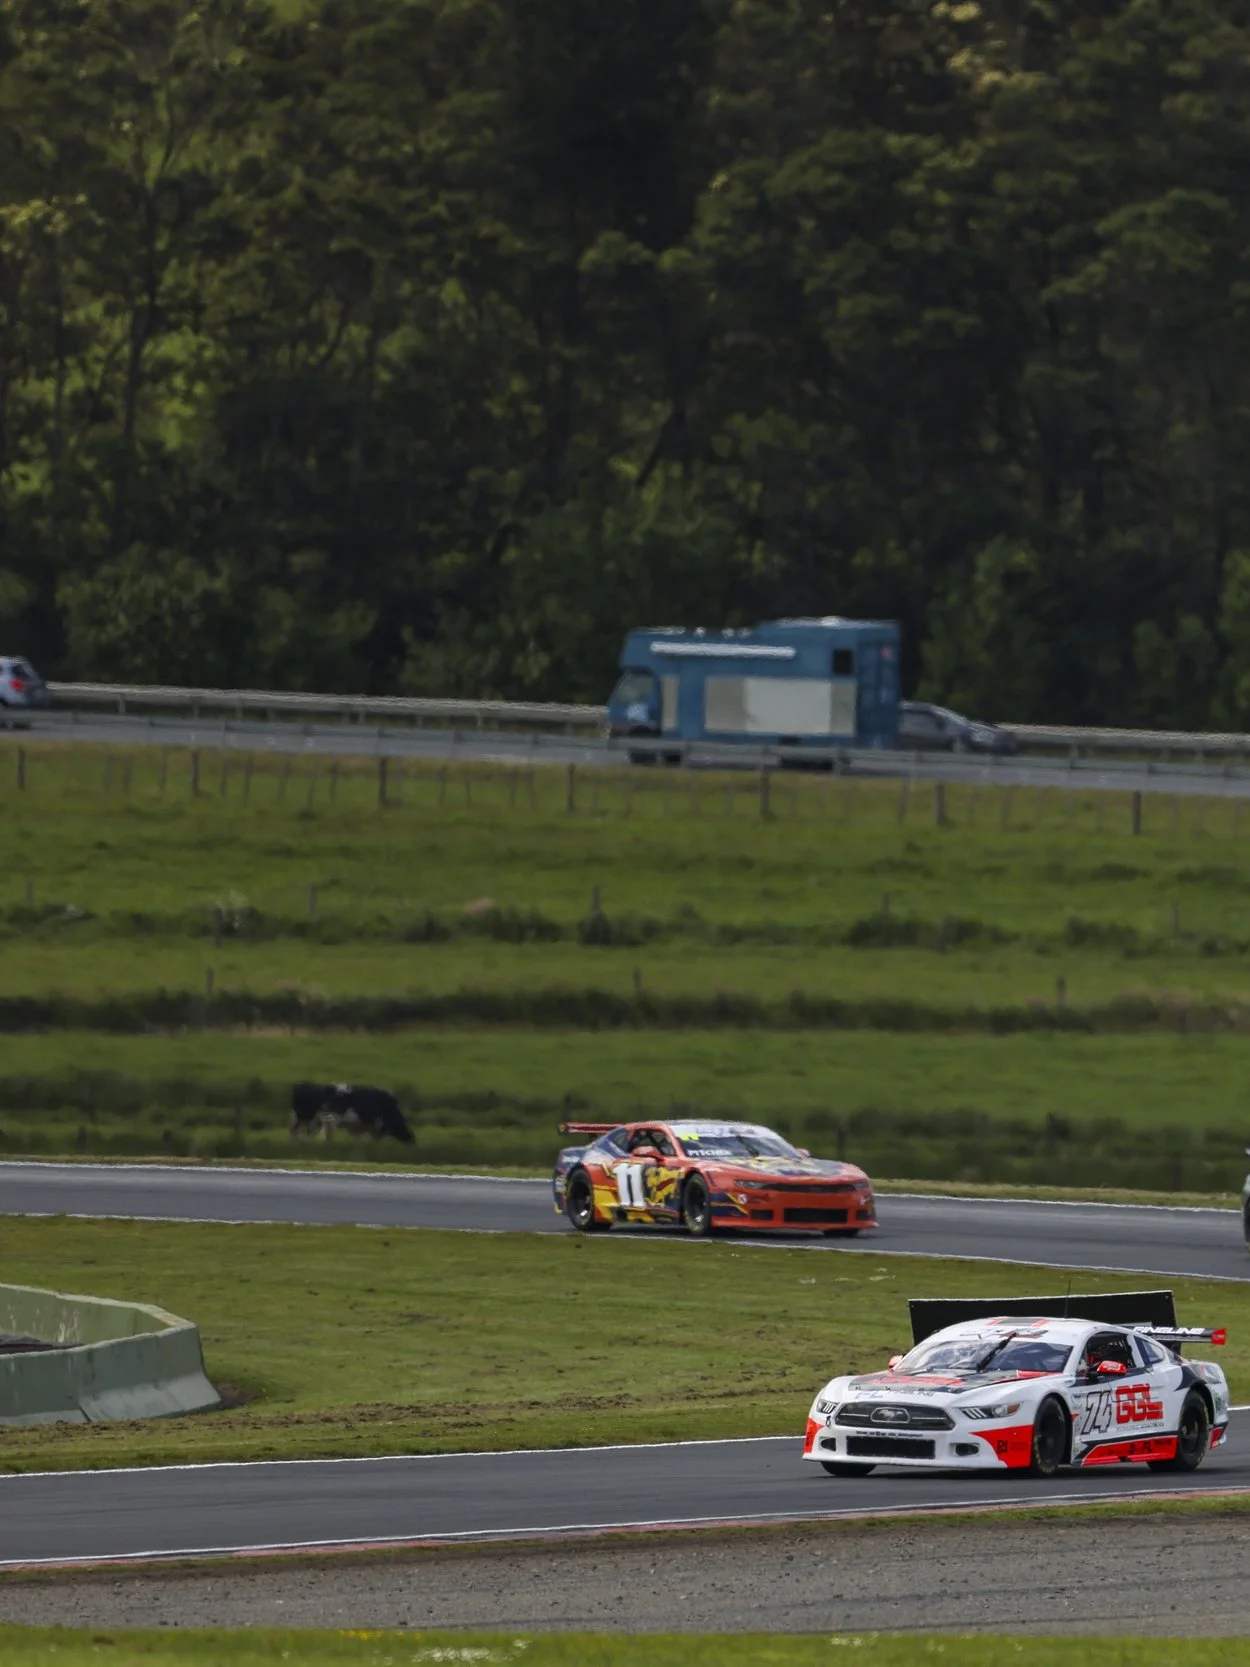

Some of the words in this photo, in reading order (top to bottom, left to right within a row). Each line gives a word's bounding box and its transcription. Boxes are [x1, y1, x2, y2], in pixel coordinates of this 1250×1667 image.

[613, 1162, 645, 1207] 11
[1080, 1390, 1112, 1435] 74
[1115, 1383, 1164, 1424] GGL
